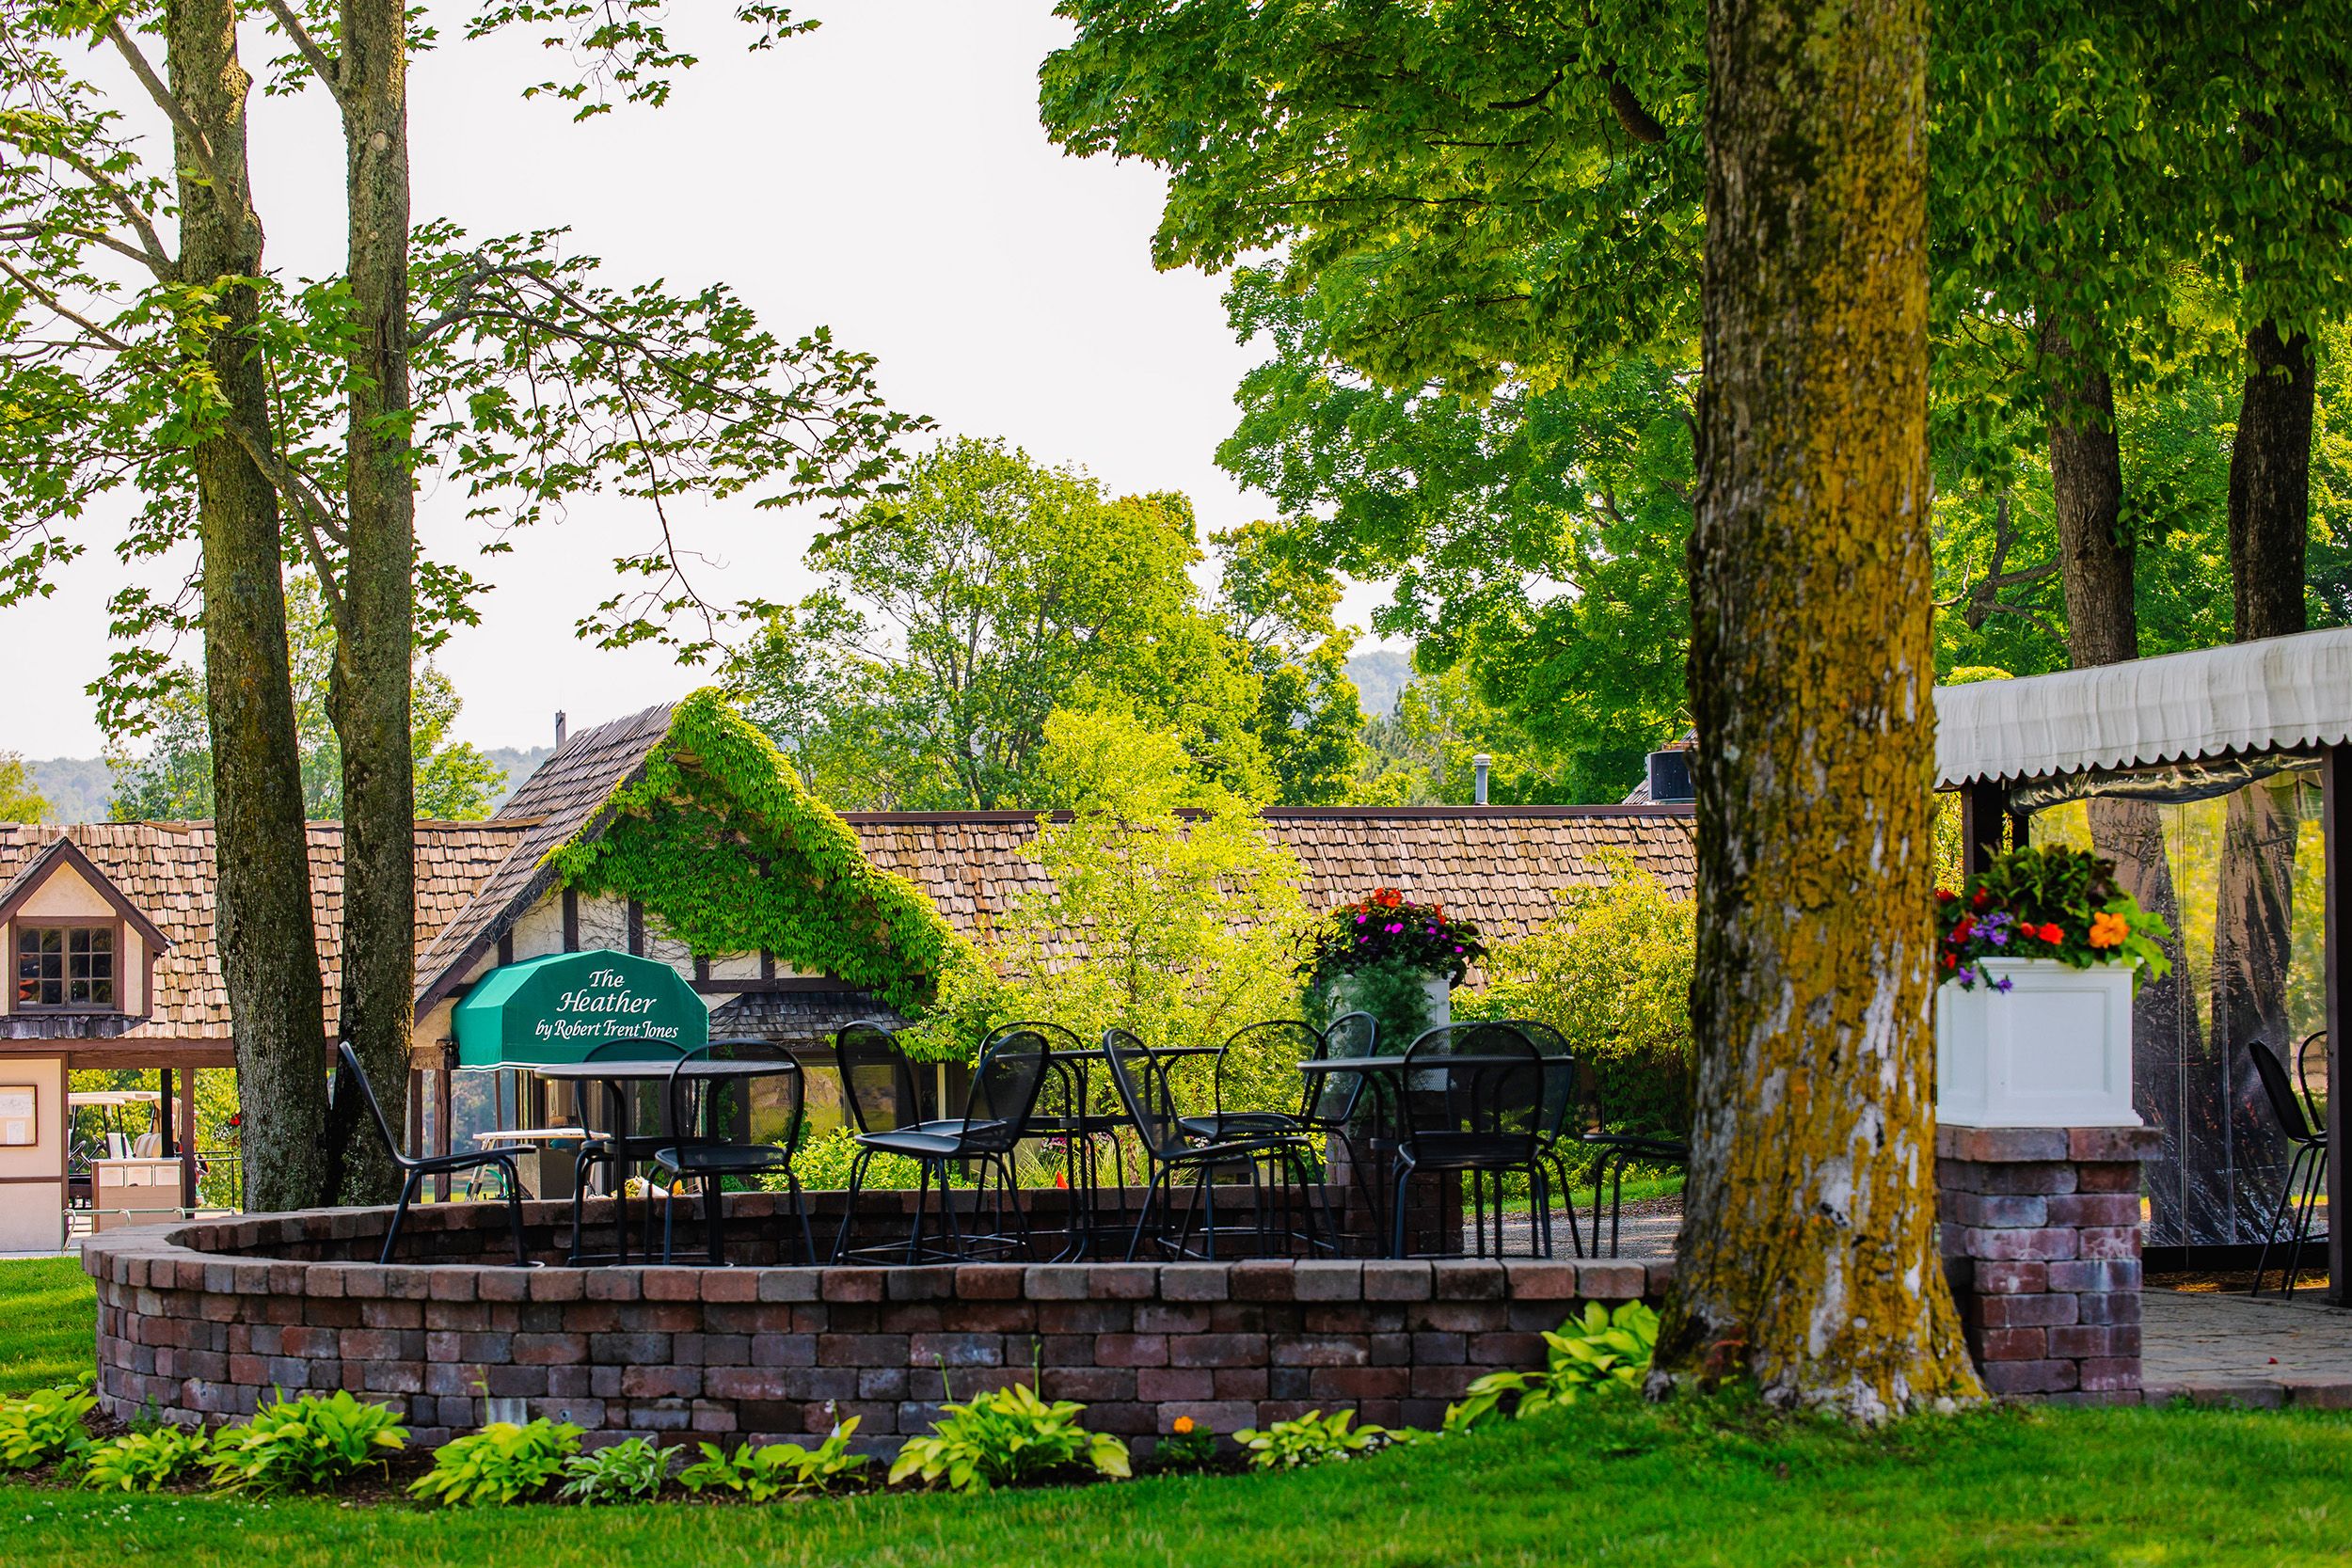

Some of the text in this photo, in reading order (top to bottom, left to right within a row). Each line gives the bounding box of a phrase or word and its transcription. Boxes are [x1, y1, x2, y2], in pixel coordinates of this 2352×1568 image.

[588, 968, 625, 988] The
[556, 989, 657, 1014] Heather
[534, 1019, 679, 1041] by Robert Trent Jones
